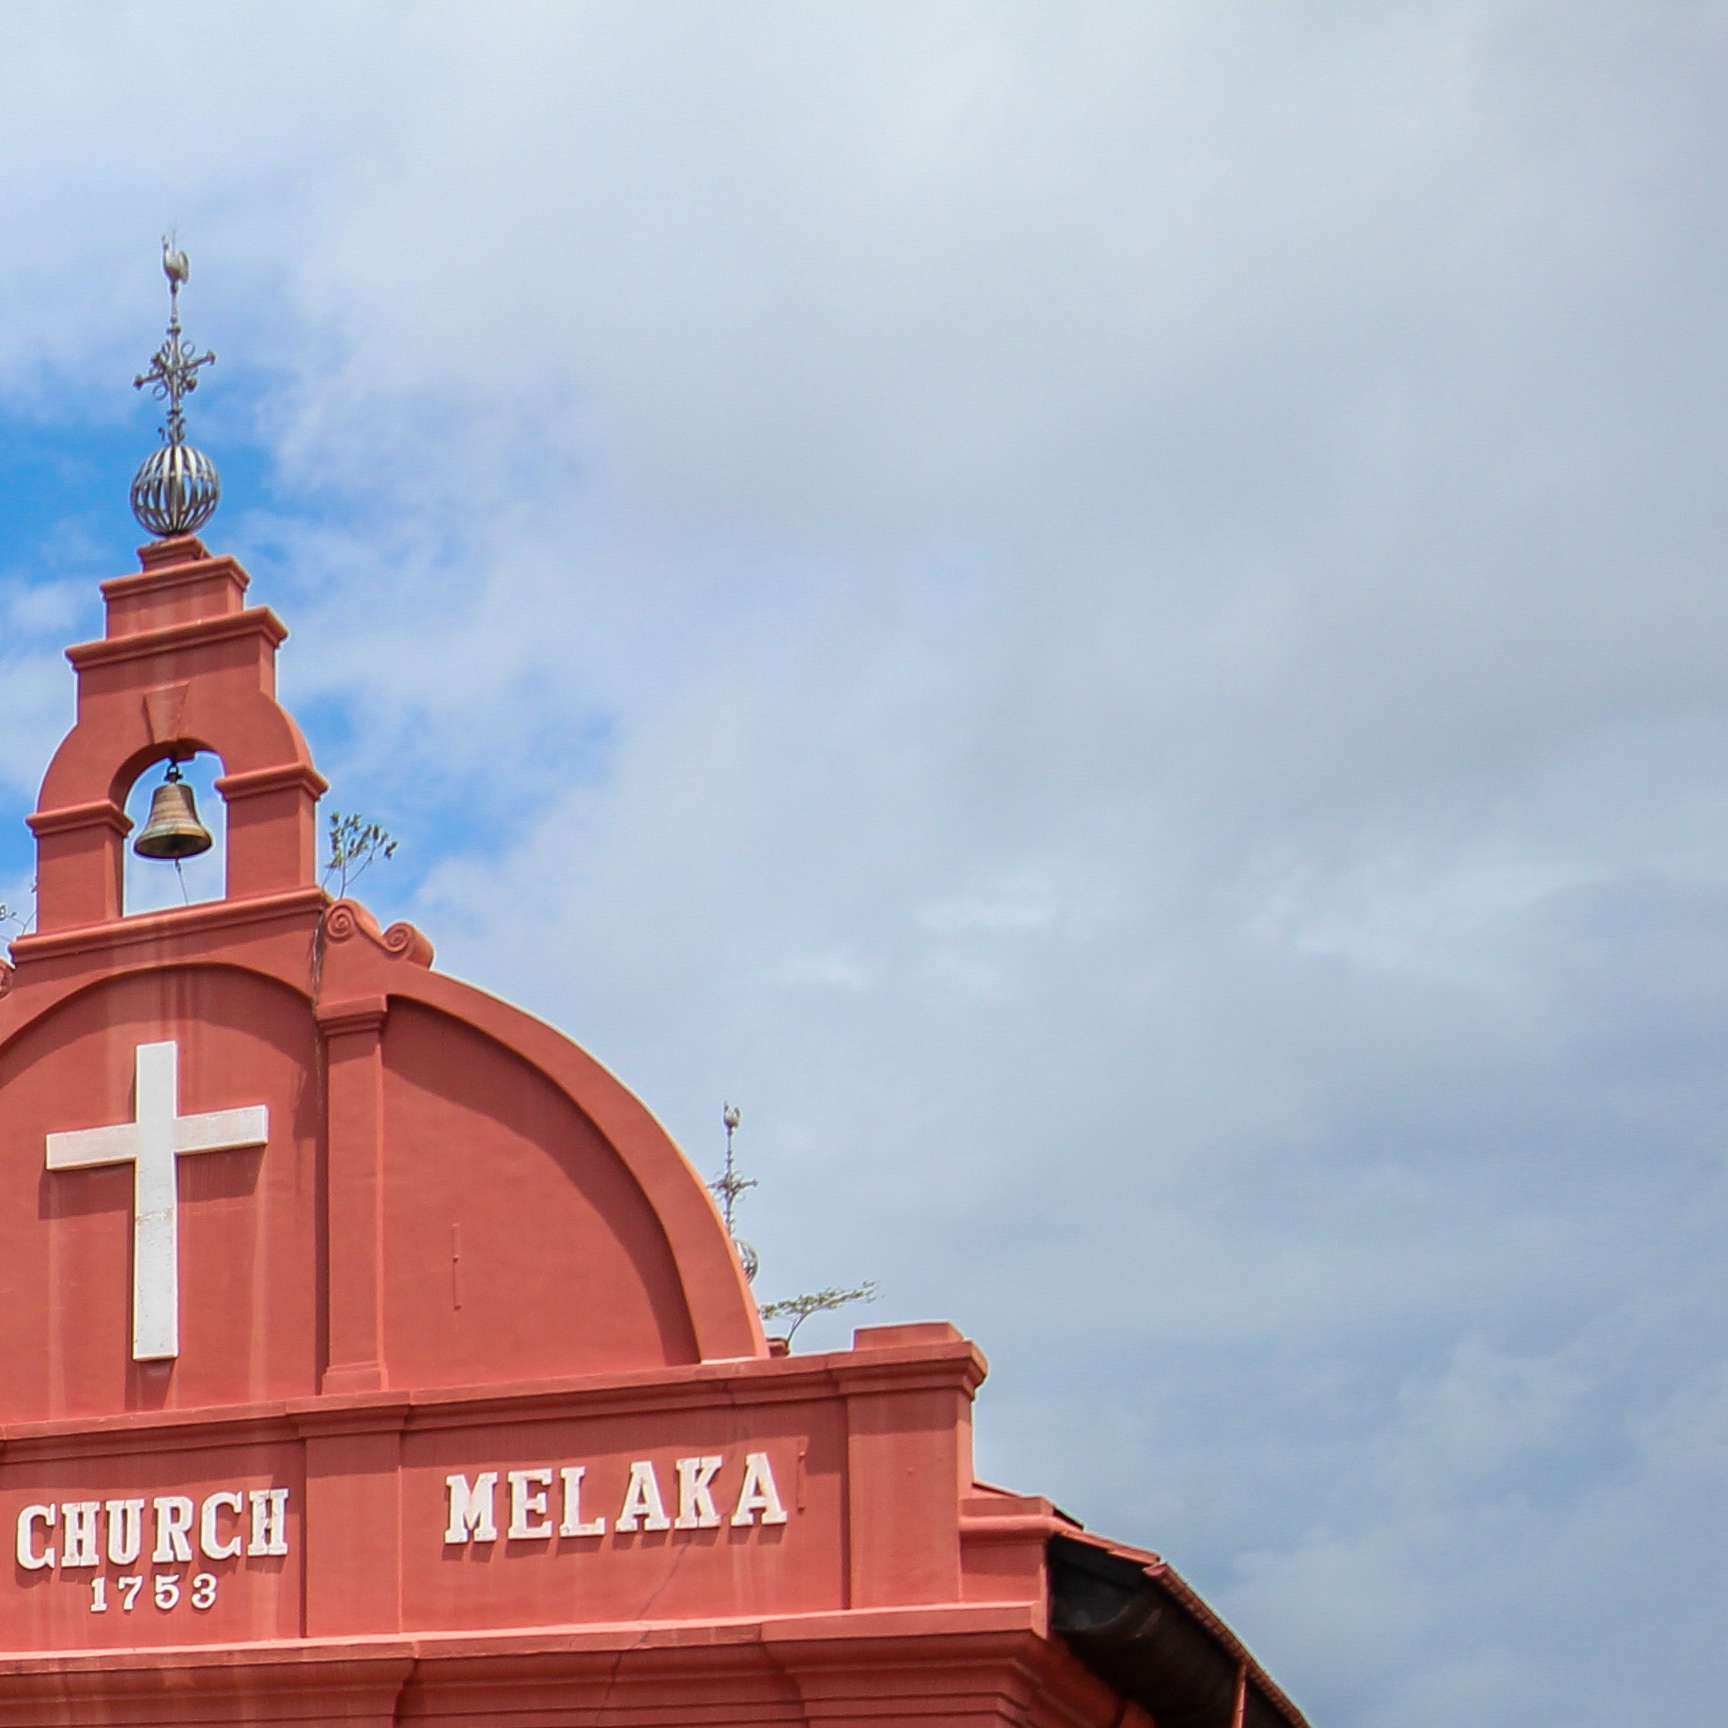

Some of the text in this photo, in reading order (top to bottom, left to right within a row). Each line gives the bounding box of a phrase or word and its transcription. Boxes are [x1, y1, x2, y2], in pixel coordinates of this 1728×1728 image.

[17, 1487, 289, 1570] CHURCH
[444, 1451, 790, 1544] MELAKA
[90, 1572, 218, 1612] 1753
